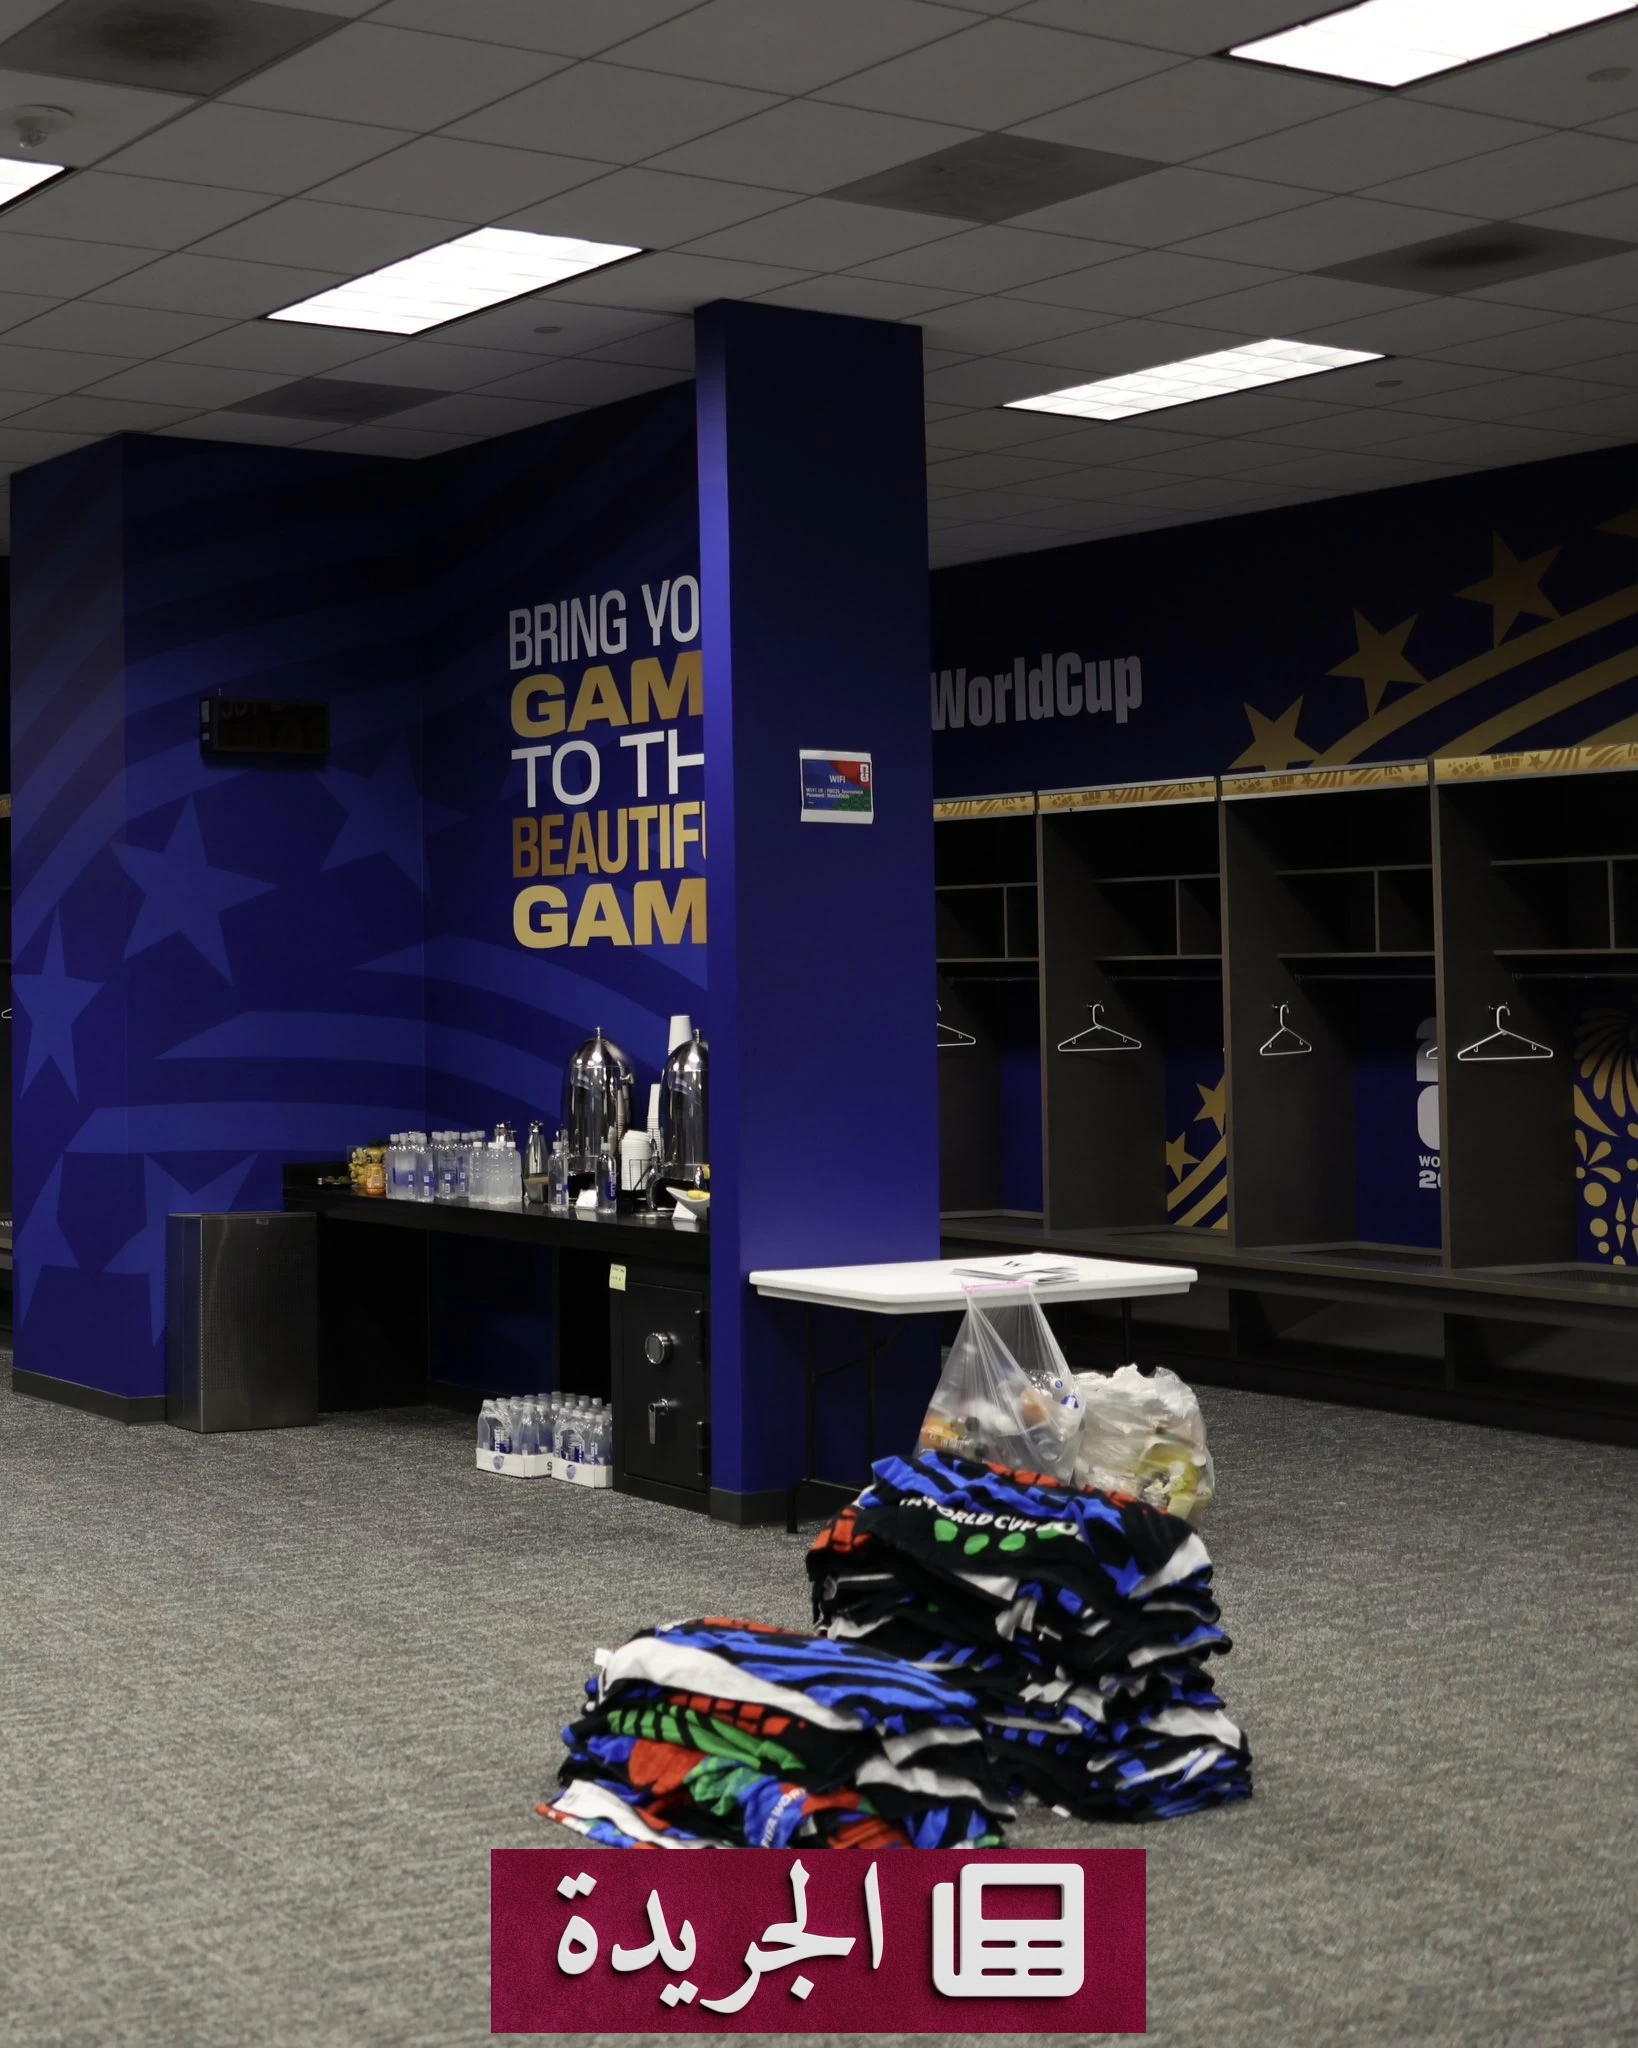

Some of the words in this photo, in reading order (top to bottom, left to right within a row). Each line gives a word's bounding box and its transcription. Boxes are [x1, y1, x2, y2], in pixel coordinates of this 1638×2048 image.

[509, 590, 627, 670] BRING
[641, 574, 700, 646] YO
[511, 649, 704, 738] GAM
[930, 652, 1143, 731] WorldCup
[511, 740, 600, 808] TO
[619, 728, 705, 798] TH
[829, 775, 846, 784] WIFI
[512, 801, 706, 878] BEAUTIF
[513, 878, 707, 949] GAM
[1418, 1155, 1441, 1168] WO
[1418, 1169, 1441, 1189] 2
